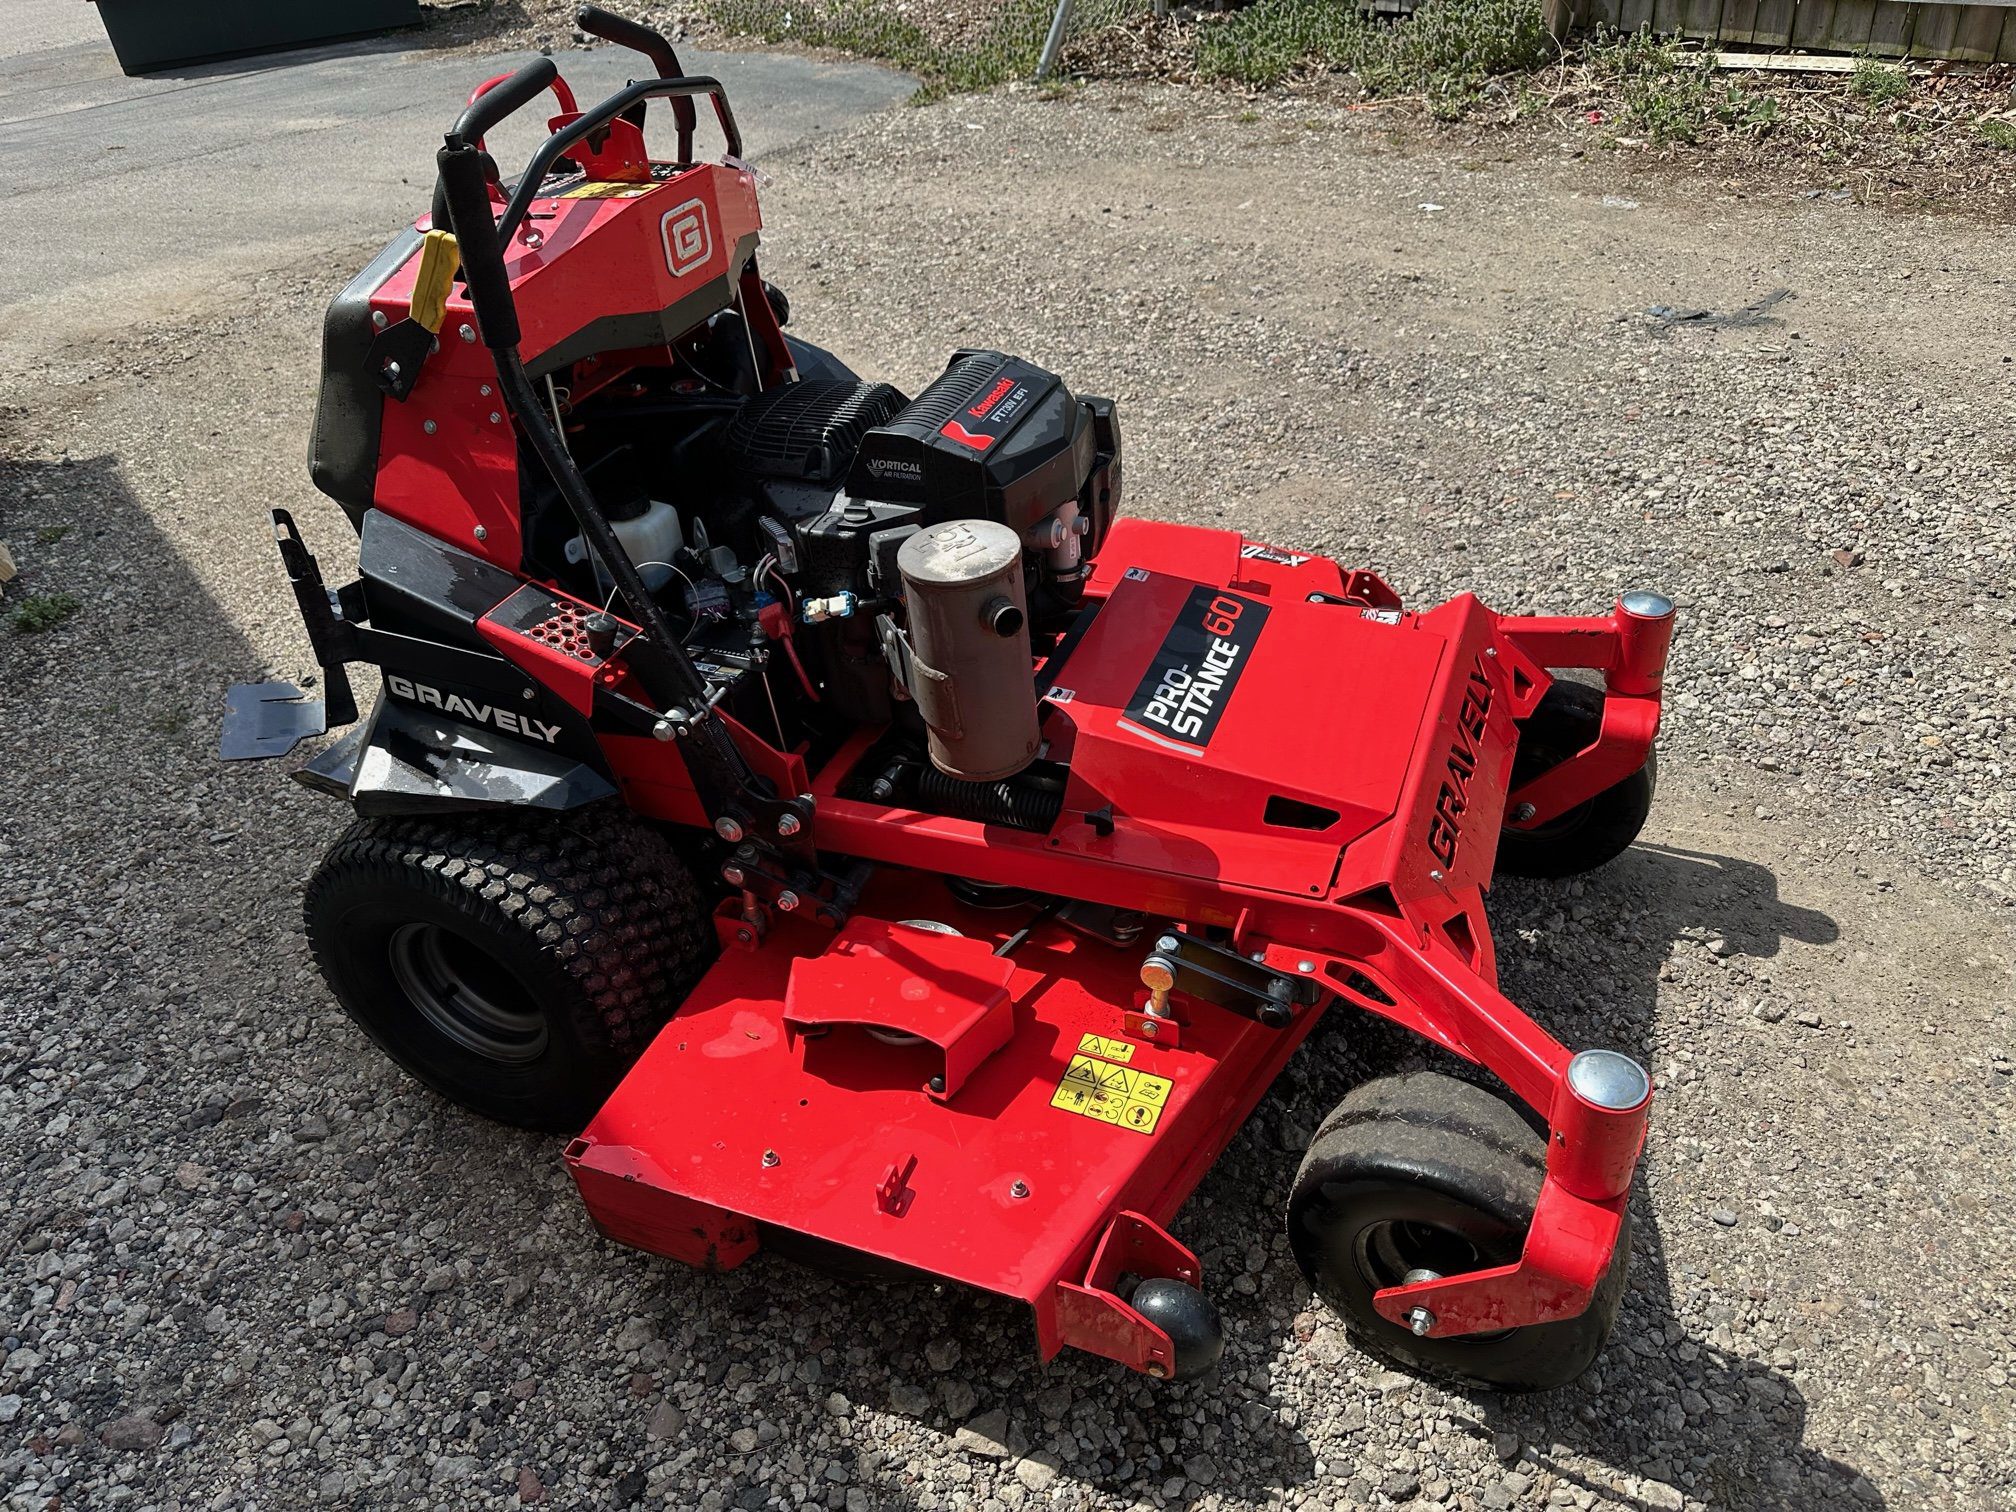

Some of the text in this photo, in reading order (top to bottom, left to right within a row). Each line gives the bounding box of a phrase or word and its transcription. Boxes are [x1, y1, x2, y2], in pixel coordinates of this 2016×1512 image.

[967, 377, 1015, 418] Kawasaki
[1012, 387, 1029, 401] EFI
[870, 458, 922, 473] VORTICAL
[883, 470, 921, 481] AIR FILTRATION
[1171, 595, 1244, 738] STANCE 60
[388, 674, 562, 743] GRAVELY
[1143, 664, 1193, 726] PRO-
[1427, 653, 1495, 872] GRAVELY
